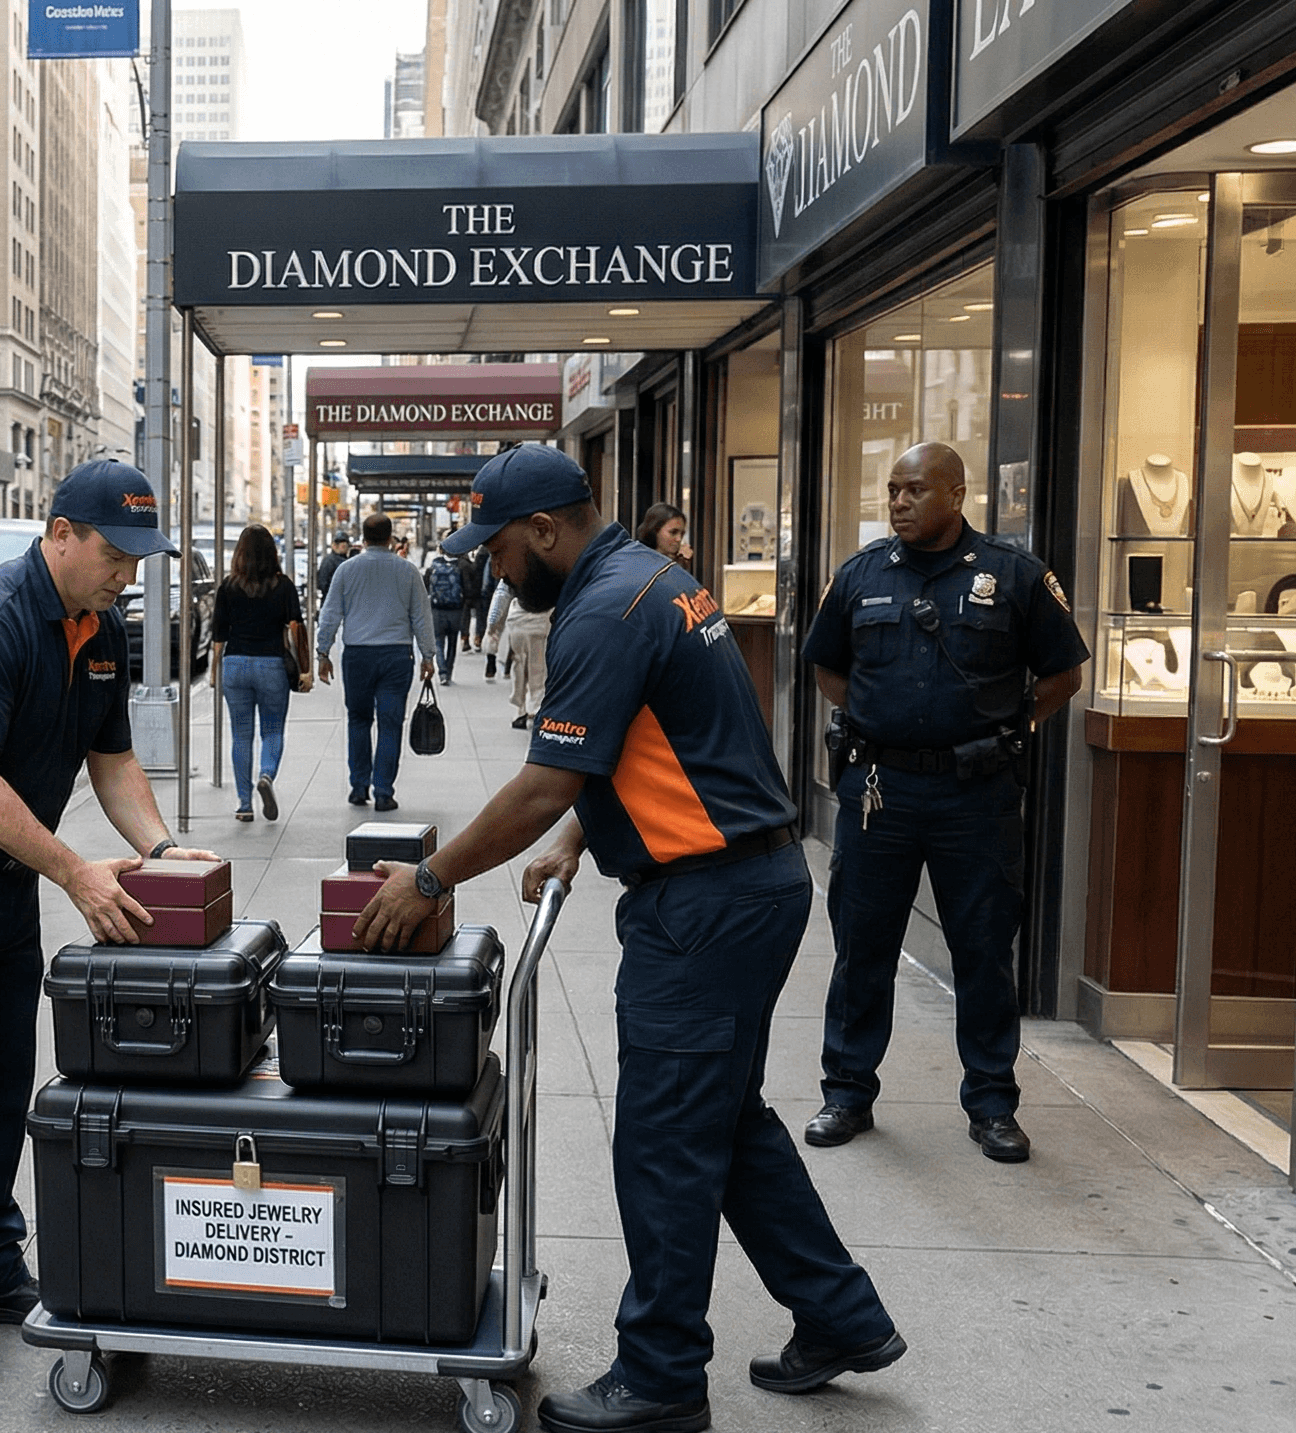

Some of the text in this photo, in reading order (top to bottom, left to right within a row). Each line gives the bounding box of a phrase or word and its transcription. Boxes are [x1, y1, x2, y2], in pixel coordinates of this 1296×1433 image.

[831, 23, 853, 79] THE
[443, 204, 516, 235] THE
[227, 244, 734, 289] DIAMOND EXCHANGE
[315, 402, 555, 423] THE DIAMOND EXCHANGE
[176, 1199, 322, 1224] INSURED JEWELRY
[206, 1223, 281, 1242] DELIVERY
[174, 1241, 325, 1267] DIAMOND DISTRICT
